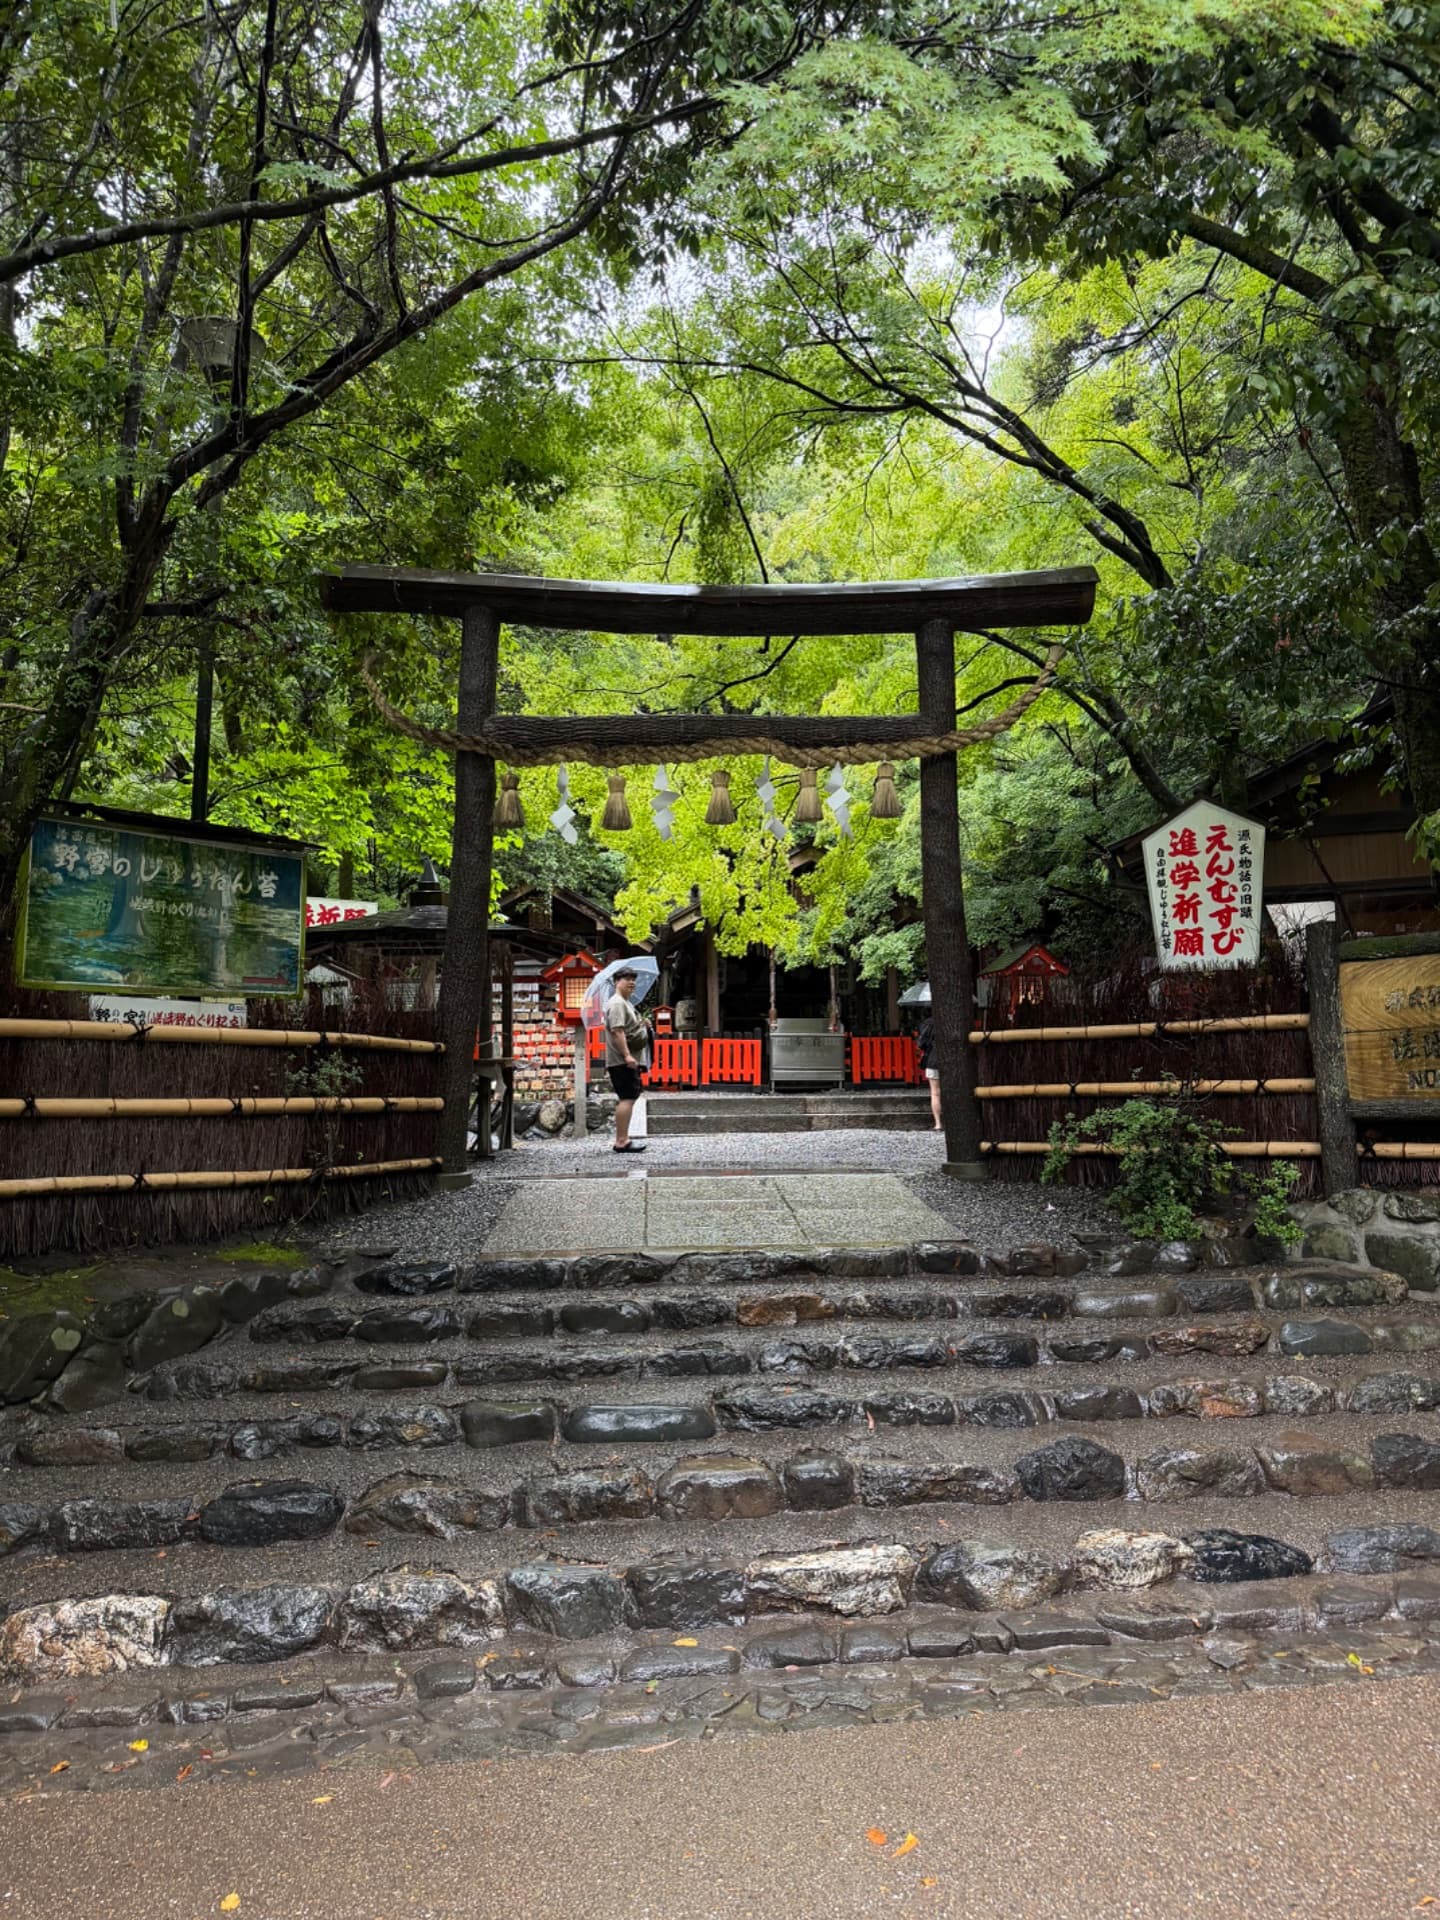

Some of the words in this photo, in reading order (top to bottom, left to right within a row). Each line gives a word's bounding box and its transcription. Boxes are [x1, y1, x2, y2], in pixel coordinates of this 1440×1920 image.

[1168, 828, 1204, 957] 進学祈願
[1205, 825, 1244, 955] えんむすび
